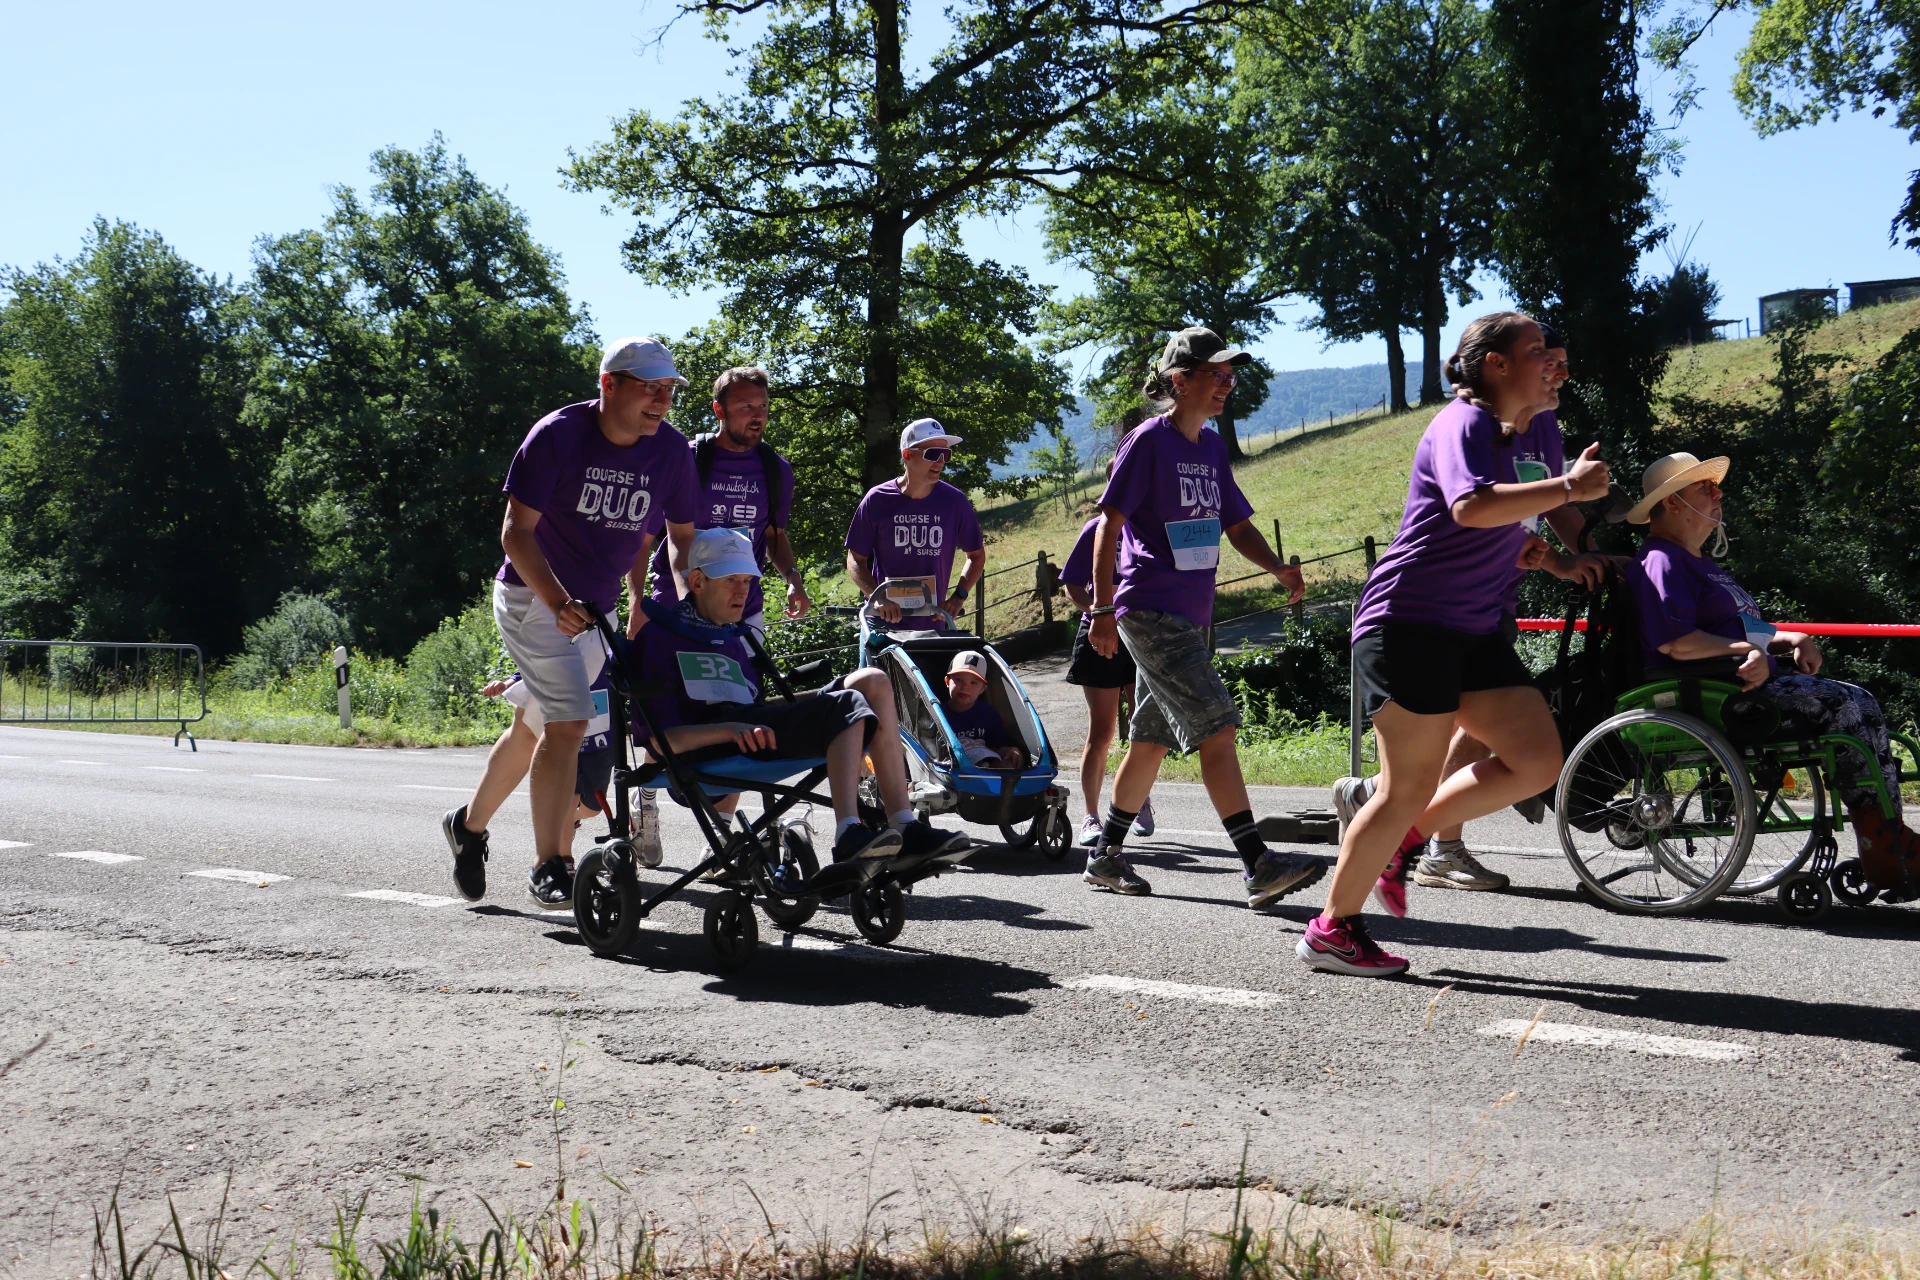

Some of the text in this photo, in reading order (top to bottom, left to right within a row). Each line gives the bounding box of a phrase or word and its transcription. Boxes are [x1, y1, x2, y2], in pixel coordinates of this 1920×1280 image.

[585, 466, 636, 486] COURSE
[1177, 462, 1209, 477] COURSE
[576, 482, 651, 522] DUO
[1180, 476, 1222, 511] DUO
[604, 520, 643, 532] SUISSE
[893, 514, 930, 524] COURSE
[894, 525, 944, 548] DUO
[1181, 523, 1213, 543] 244
[916, 548, 942, 556] SUISSE
[696, 656, 734, 681] 32
